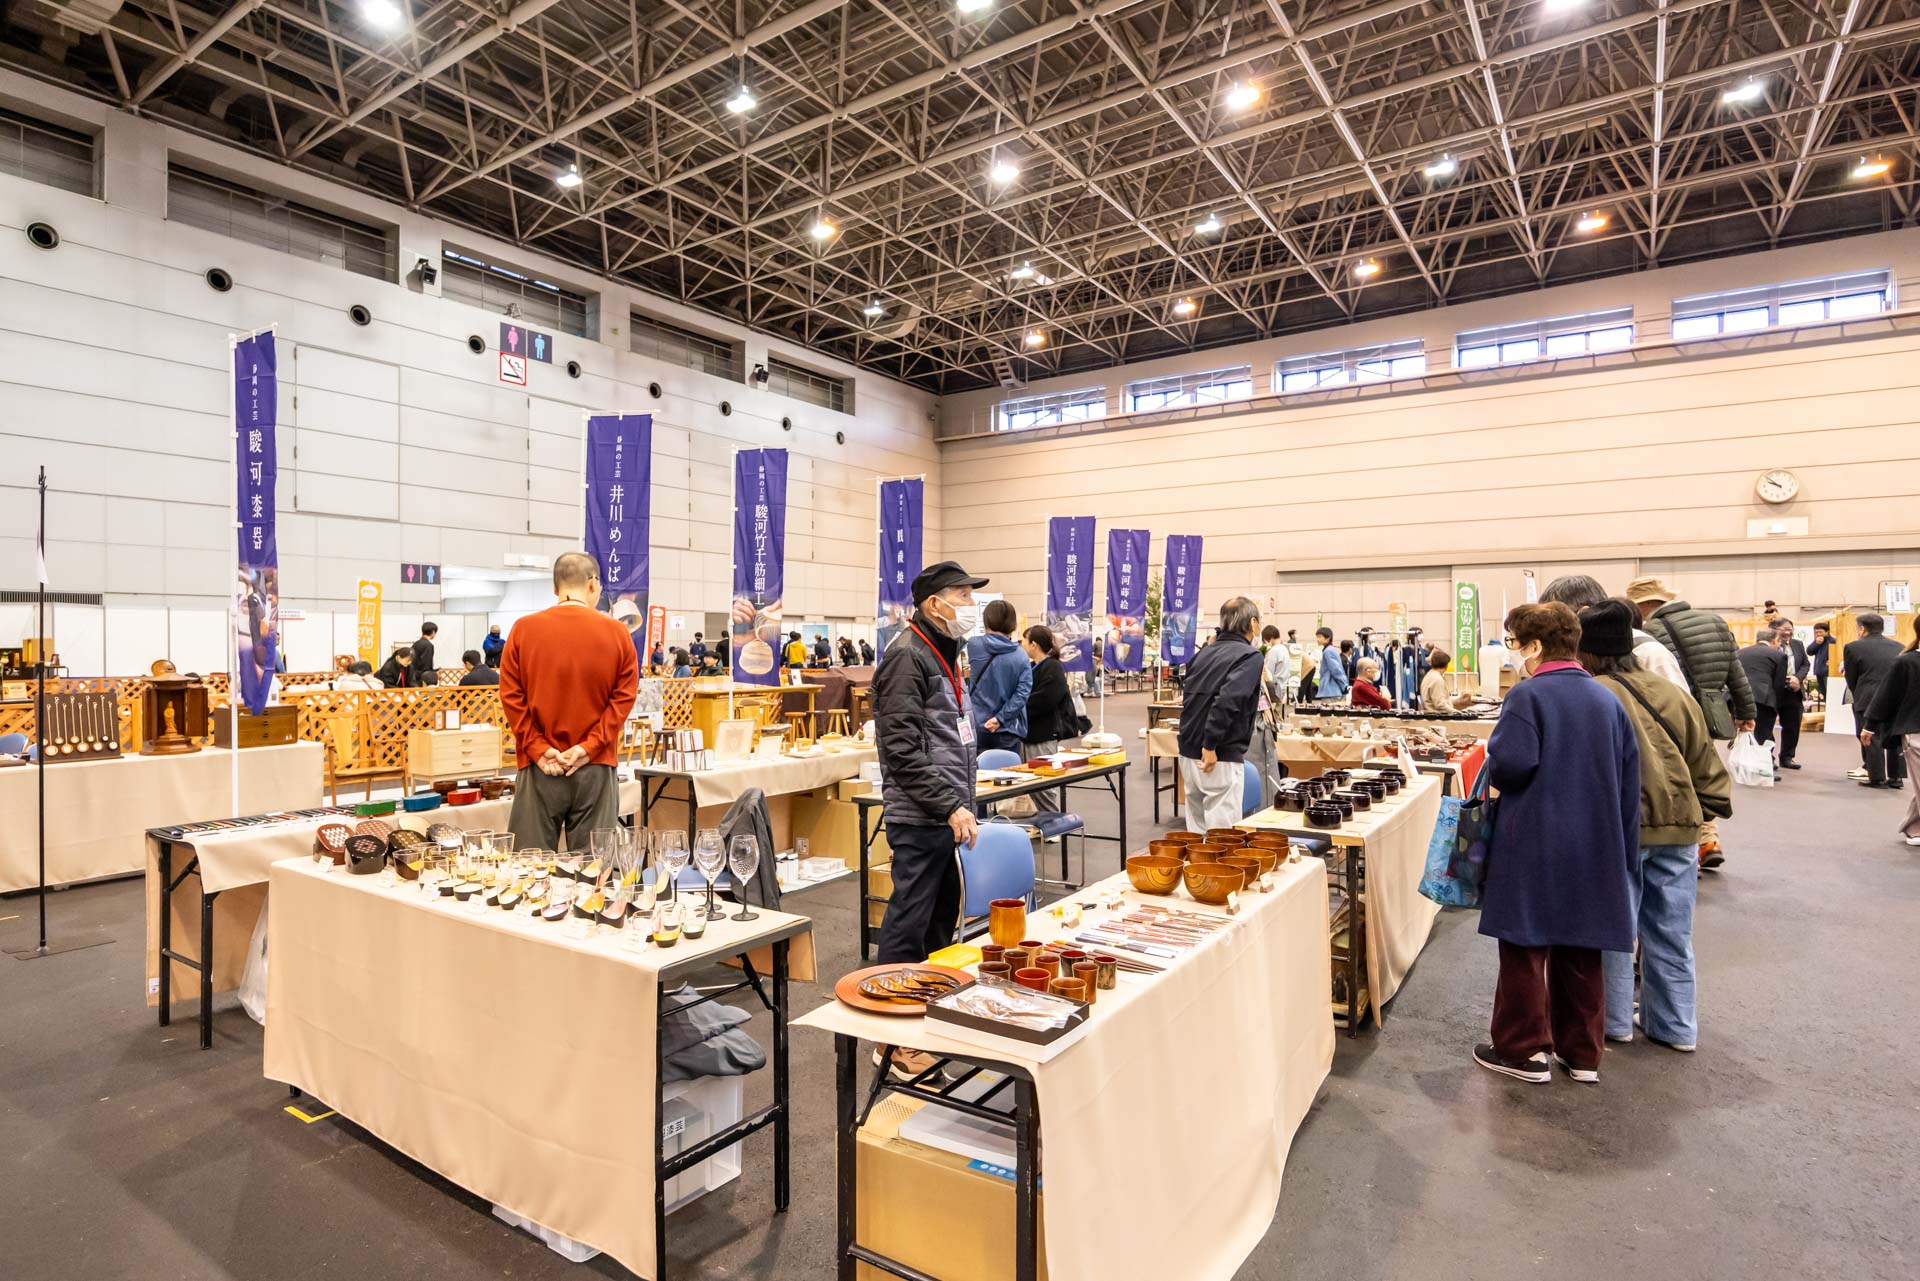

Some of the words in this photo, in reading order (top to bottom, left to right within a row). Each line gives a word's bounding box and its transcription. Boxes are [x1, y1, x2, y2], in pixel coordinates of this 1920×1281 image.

[249, 429, 263, 550] 駿河漆器
[614, 435, 623, 478] 静岡の工芸
[758, 465, 766, 502] 静岡の工芸
[607, 484, 625, 582] 井川めんぱ
[754, 503, 769, 605] 駿河竹千筋細工
[1065, 553, 1078, 607] 駿河張下駄
